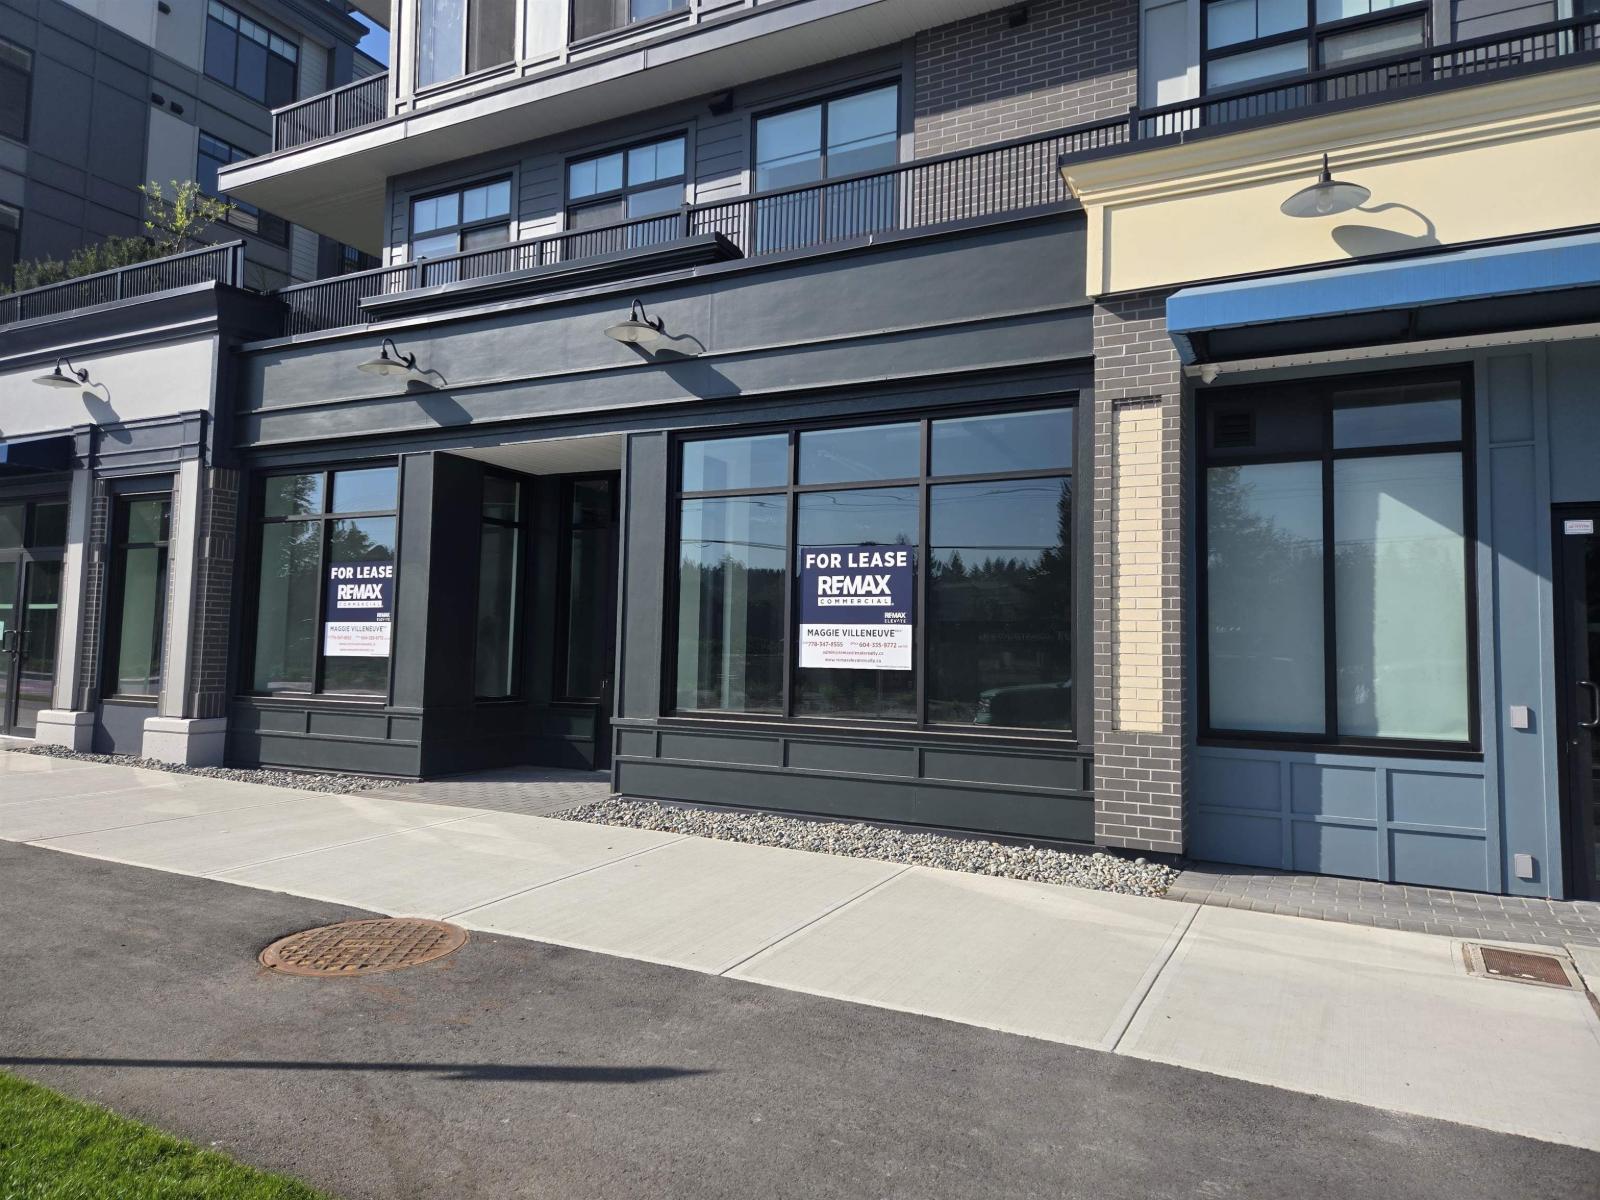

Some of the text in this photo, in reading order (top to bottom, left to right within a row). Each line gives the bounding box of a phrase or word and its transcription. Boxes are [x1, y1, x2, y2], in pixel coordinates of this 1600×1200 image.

[805, 551, 907, 569] FOR LEASE
[331, 565, 393, 580] FOR LEASE
[807, 628, 840, 637] MAGGIE
[842, 629, 895, 638] VILLENEUVE
